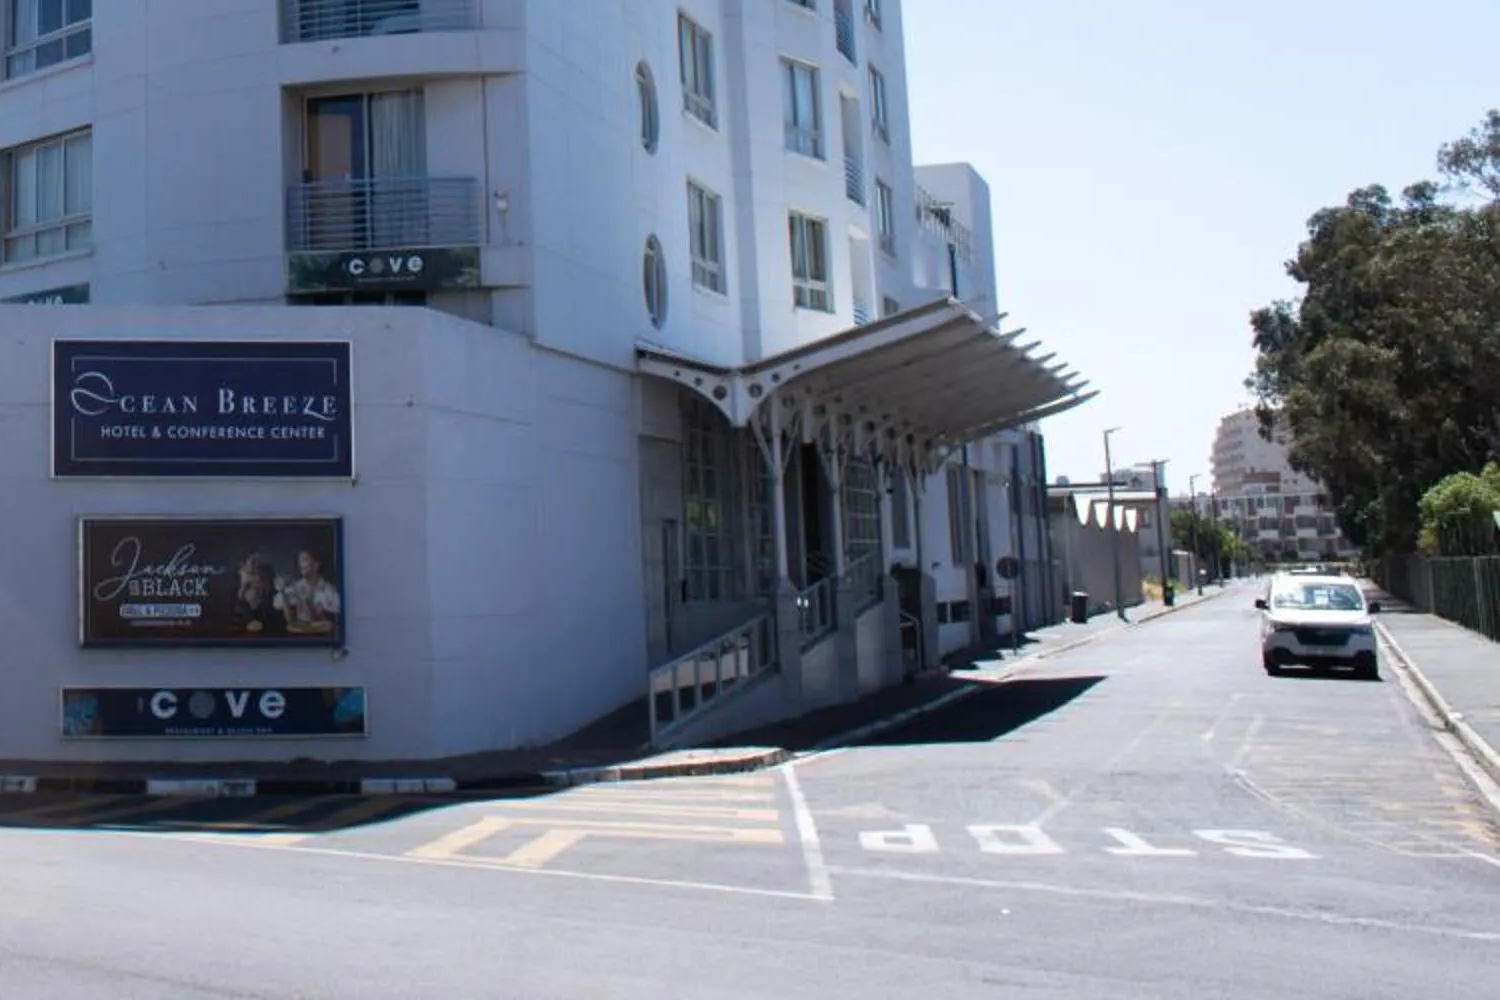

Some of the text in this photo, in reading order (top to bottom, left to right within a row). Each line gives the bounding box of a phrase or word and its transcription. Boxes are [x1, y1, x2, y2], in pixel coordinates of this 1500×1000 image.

[100, 425, 326, 439] HOTEL & CONFERENCE CENTER
[142, 577, 209, 597] BLACK
[857, 823, 1322, 859] STOP
